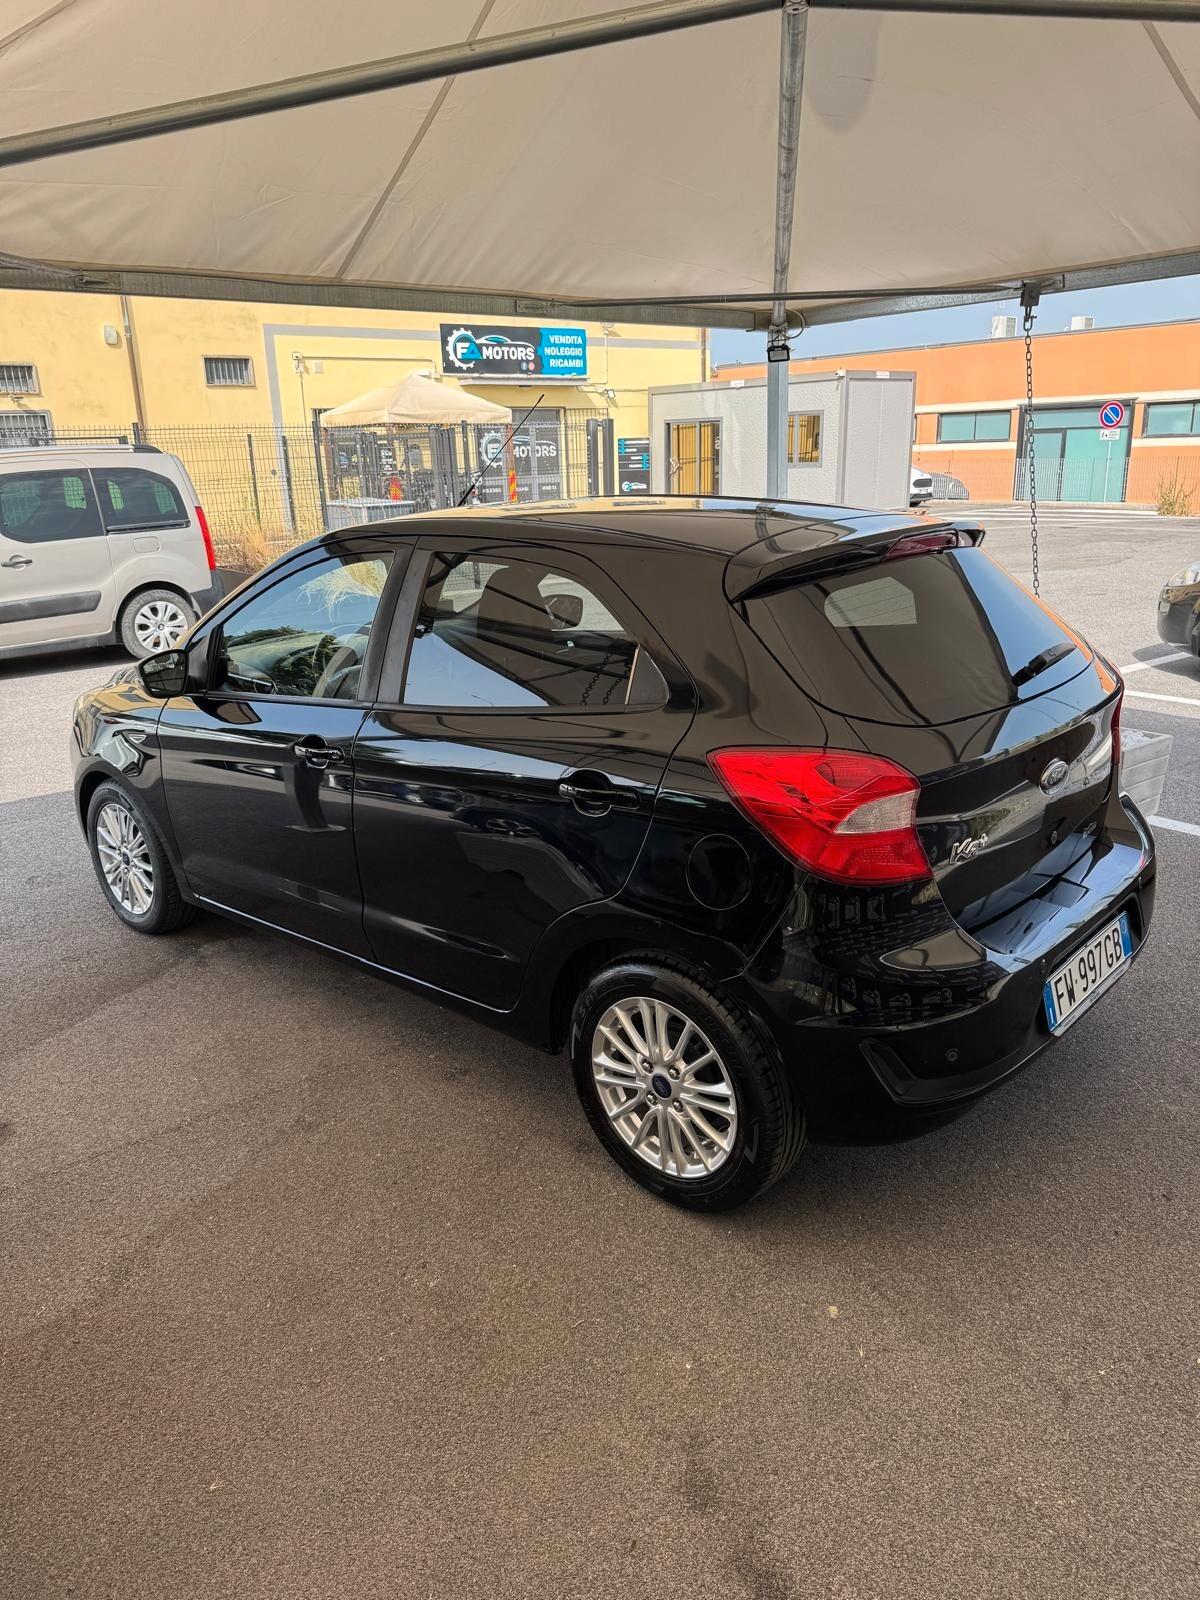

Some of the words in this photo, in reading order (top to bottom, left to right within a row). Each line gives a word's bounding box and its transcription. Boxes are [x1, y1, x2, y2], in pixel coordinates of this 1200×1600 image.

[550, 335, 583, 345] VENDITA
[482, 346, 535, 361] MOTORS
[544, 347, 583, 356] NOLEGGIO
[550, 359, 583, 368] RICAMBI
